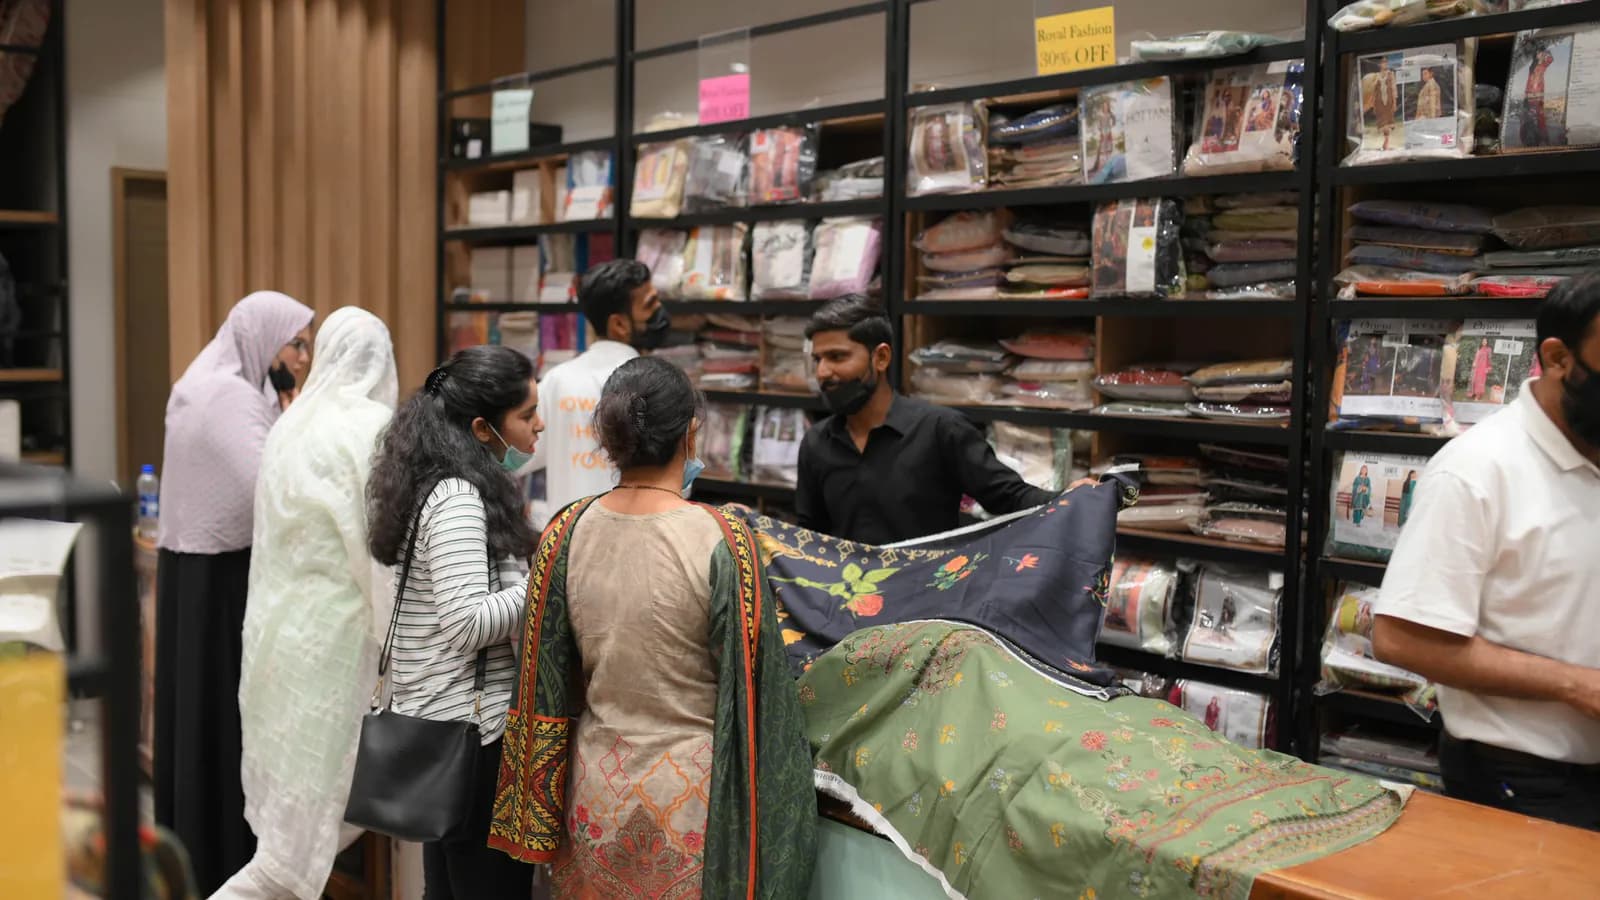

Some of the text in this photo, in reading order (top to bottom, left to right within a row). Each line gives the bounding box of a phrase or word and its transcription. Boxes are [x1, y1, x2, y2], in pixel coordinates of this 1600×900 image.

[1037, 23, 1112, 43] Royal Fashion
[1040, 44, 1110, 67] 30% OFF
